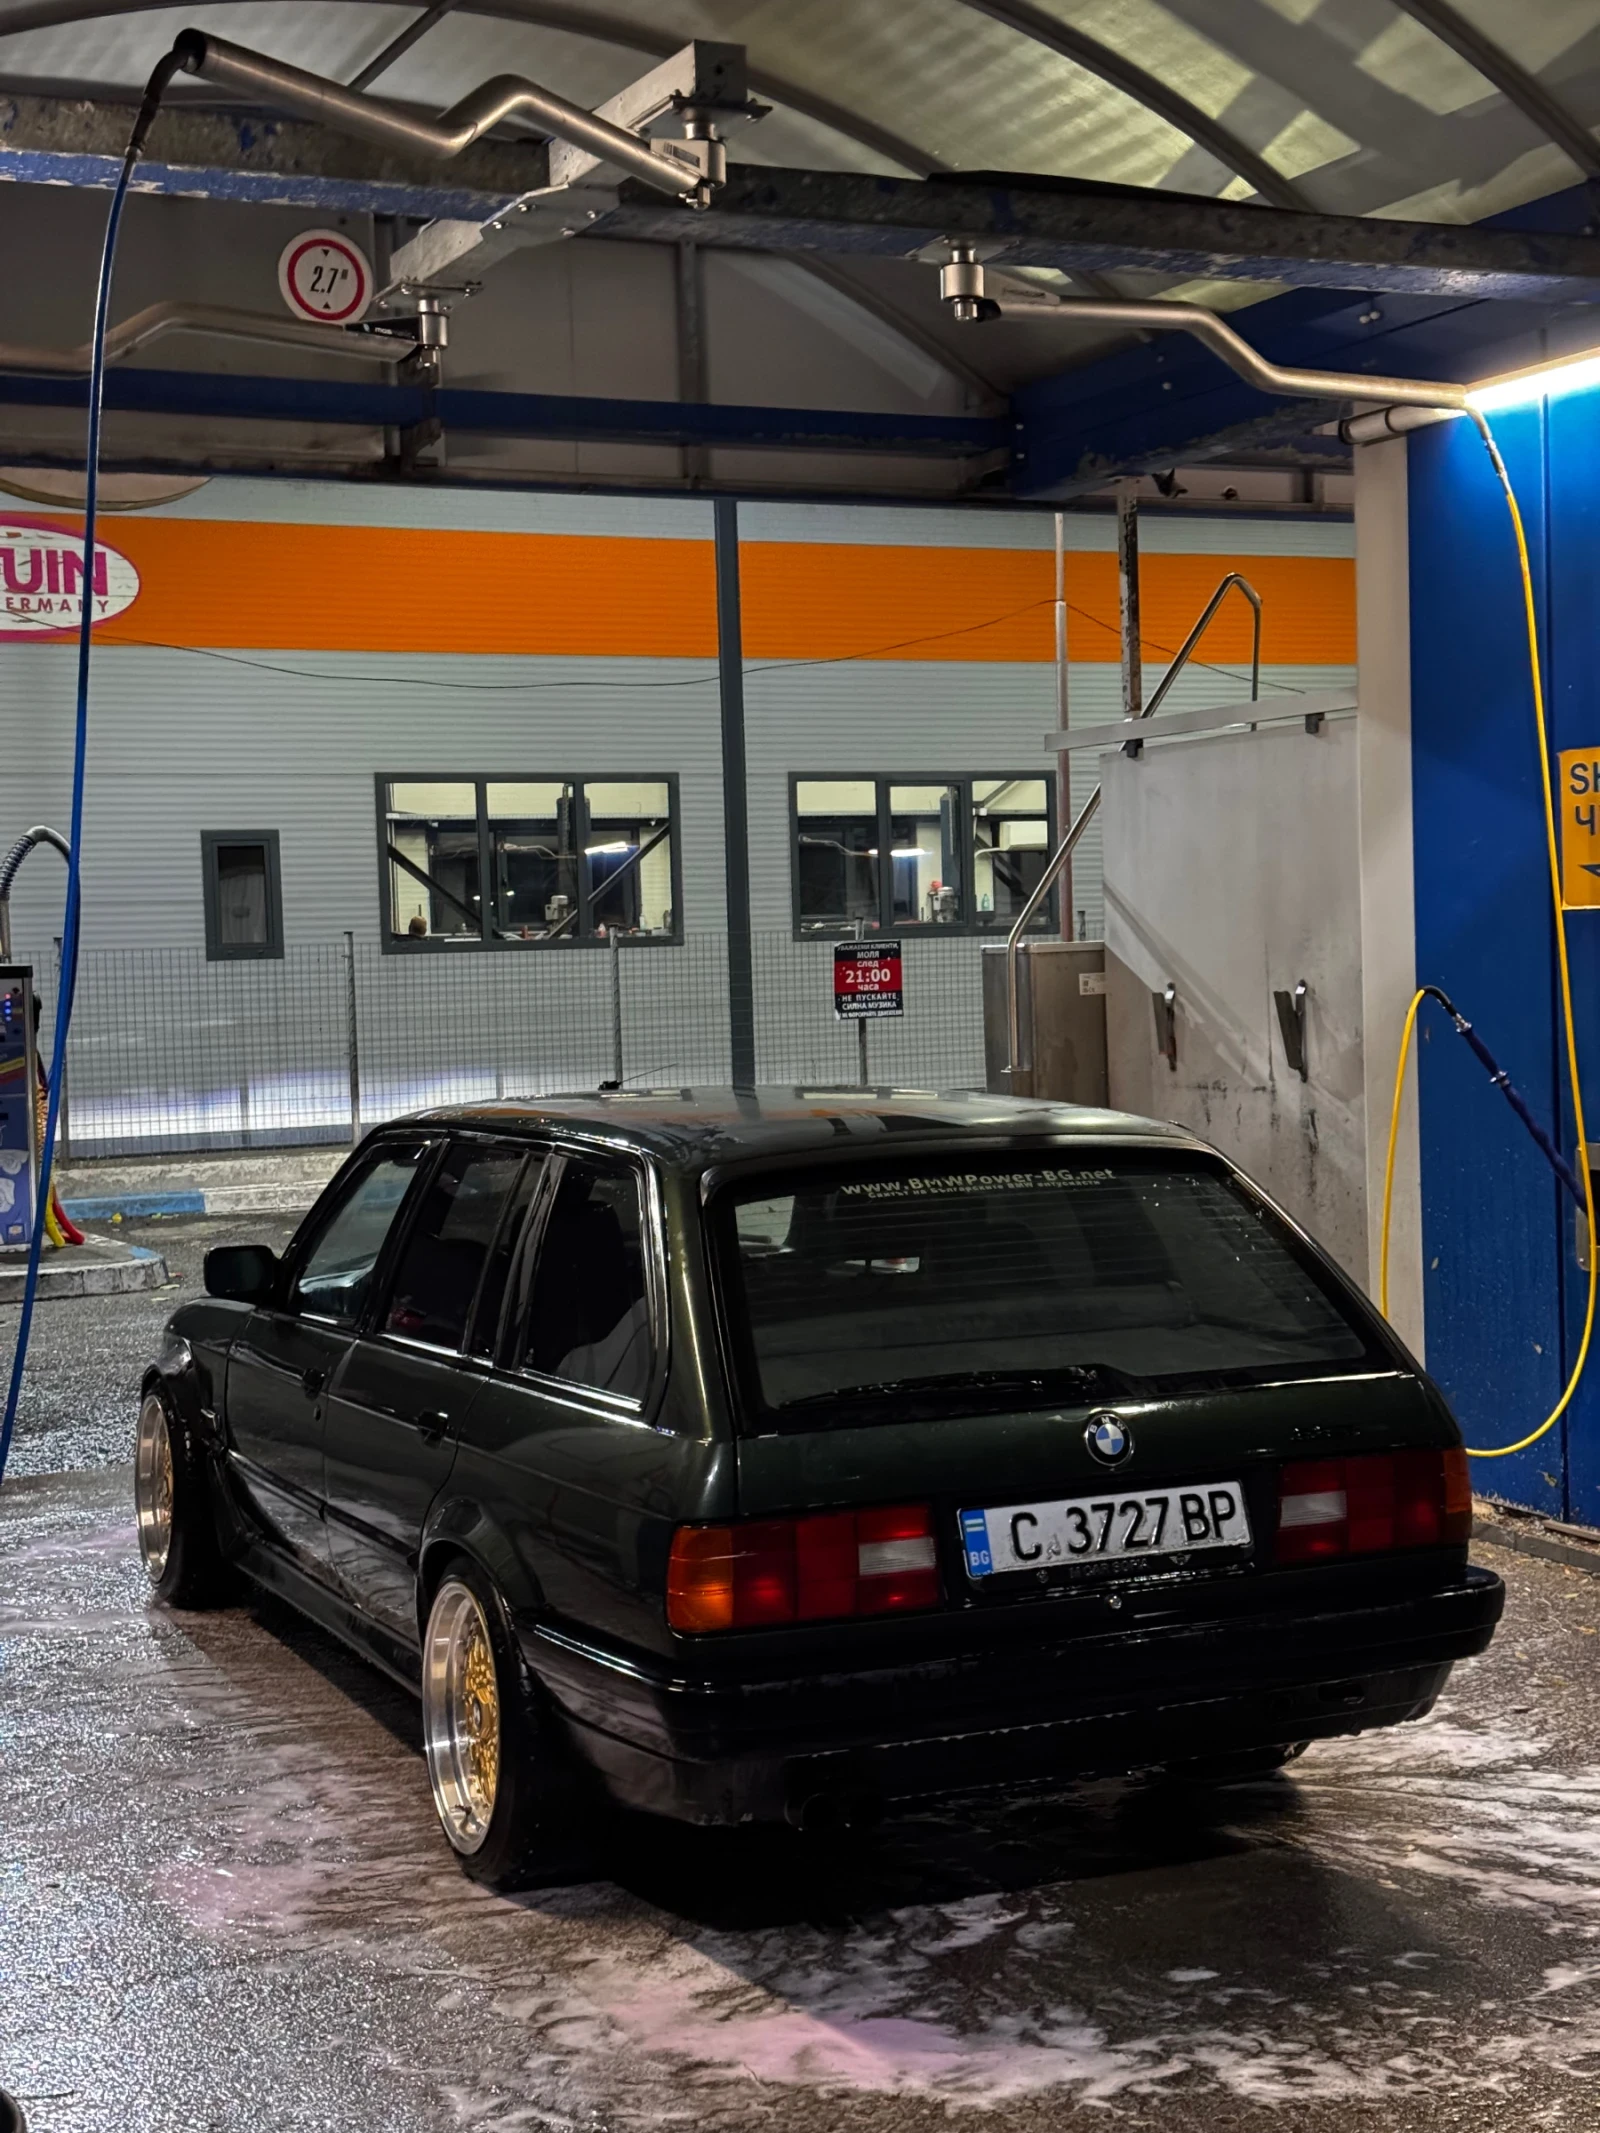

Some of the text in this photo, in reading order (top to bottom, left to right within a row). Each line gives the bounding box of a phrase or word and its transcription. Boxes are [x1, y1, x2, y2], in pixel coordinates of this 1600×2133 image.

[0, 547, 108, 597] UIN
[6, 597, 109, 613] ERMAY
[857, 951, 880, 959] МОЛЯ
[845, 968, 891, 983] 21:00
[857, 983, 879, 991] часа
[842, 992, 897, 1002] НЕ ПУСКАЙТЕ
[842, 1001, 897, 1010] СИЛНА МУЗИКА
[1089, 1416, 1126, 1434] BMW
[1010, 1490, 1236, 1561] C 3727 BP
[970, 1550, 990, 1566] BG
